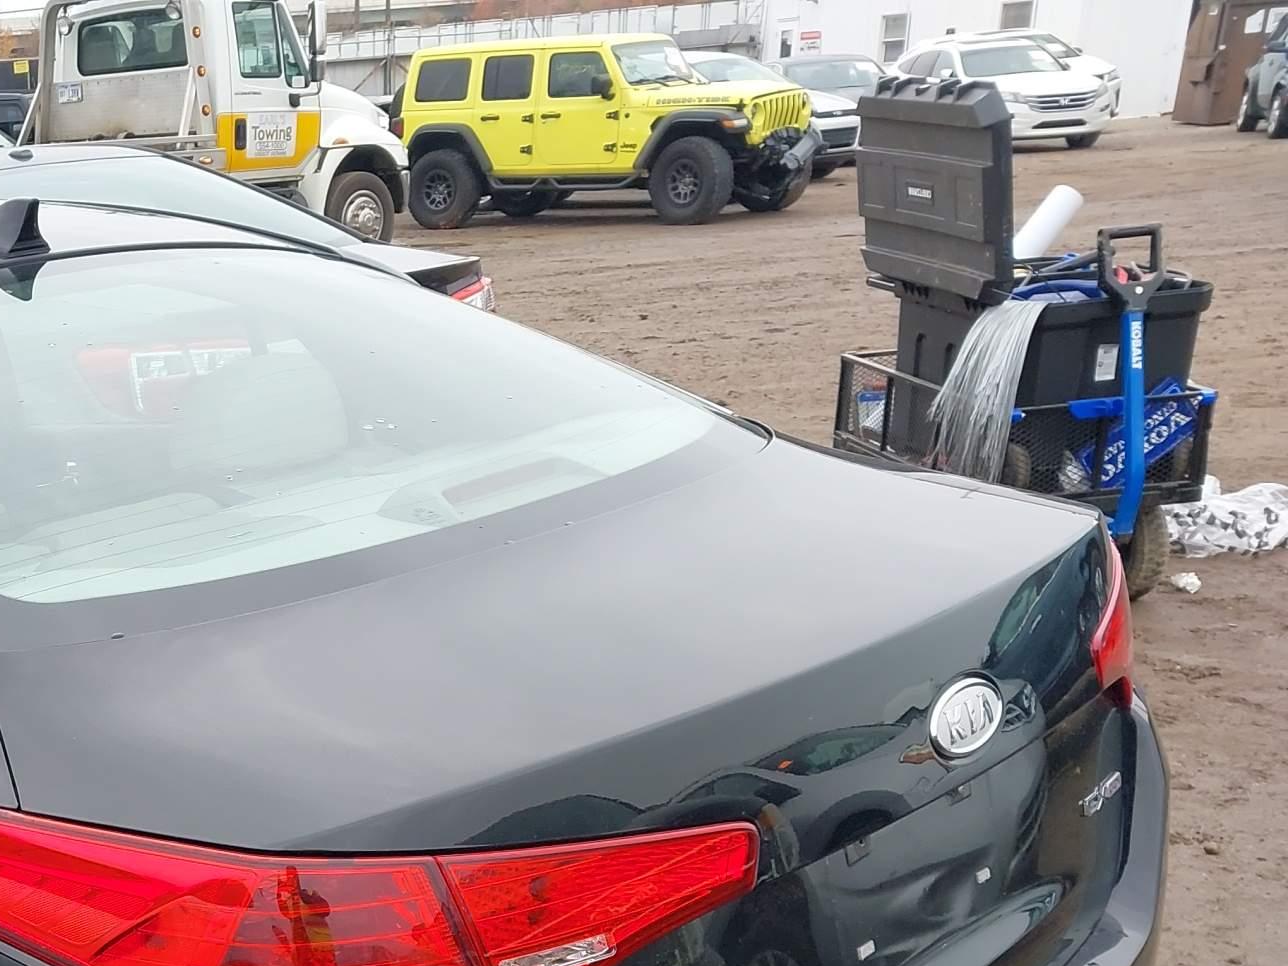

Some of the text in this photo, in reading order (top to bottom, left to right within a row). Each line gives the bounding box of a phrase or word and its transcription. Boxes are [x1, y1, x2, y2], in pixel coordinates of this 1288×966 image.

[251, 125, 292, 141] Towing
[1130, 320, 1143, 369] KOBALT
[943, 691, 995, 746] KIA
